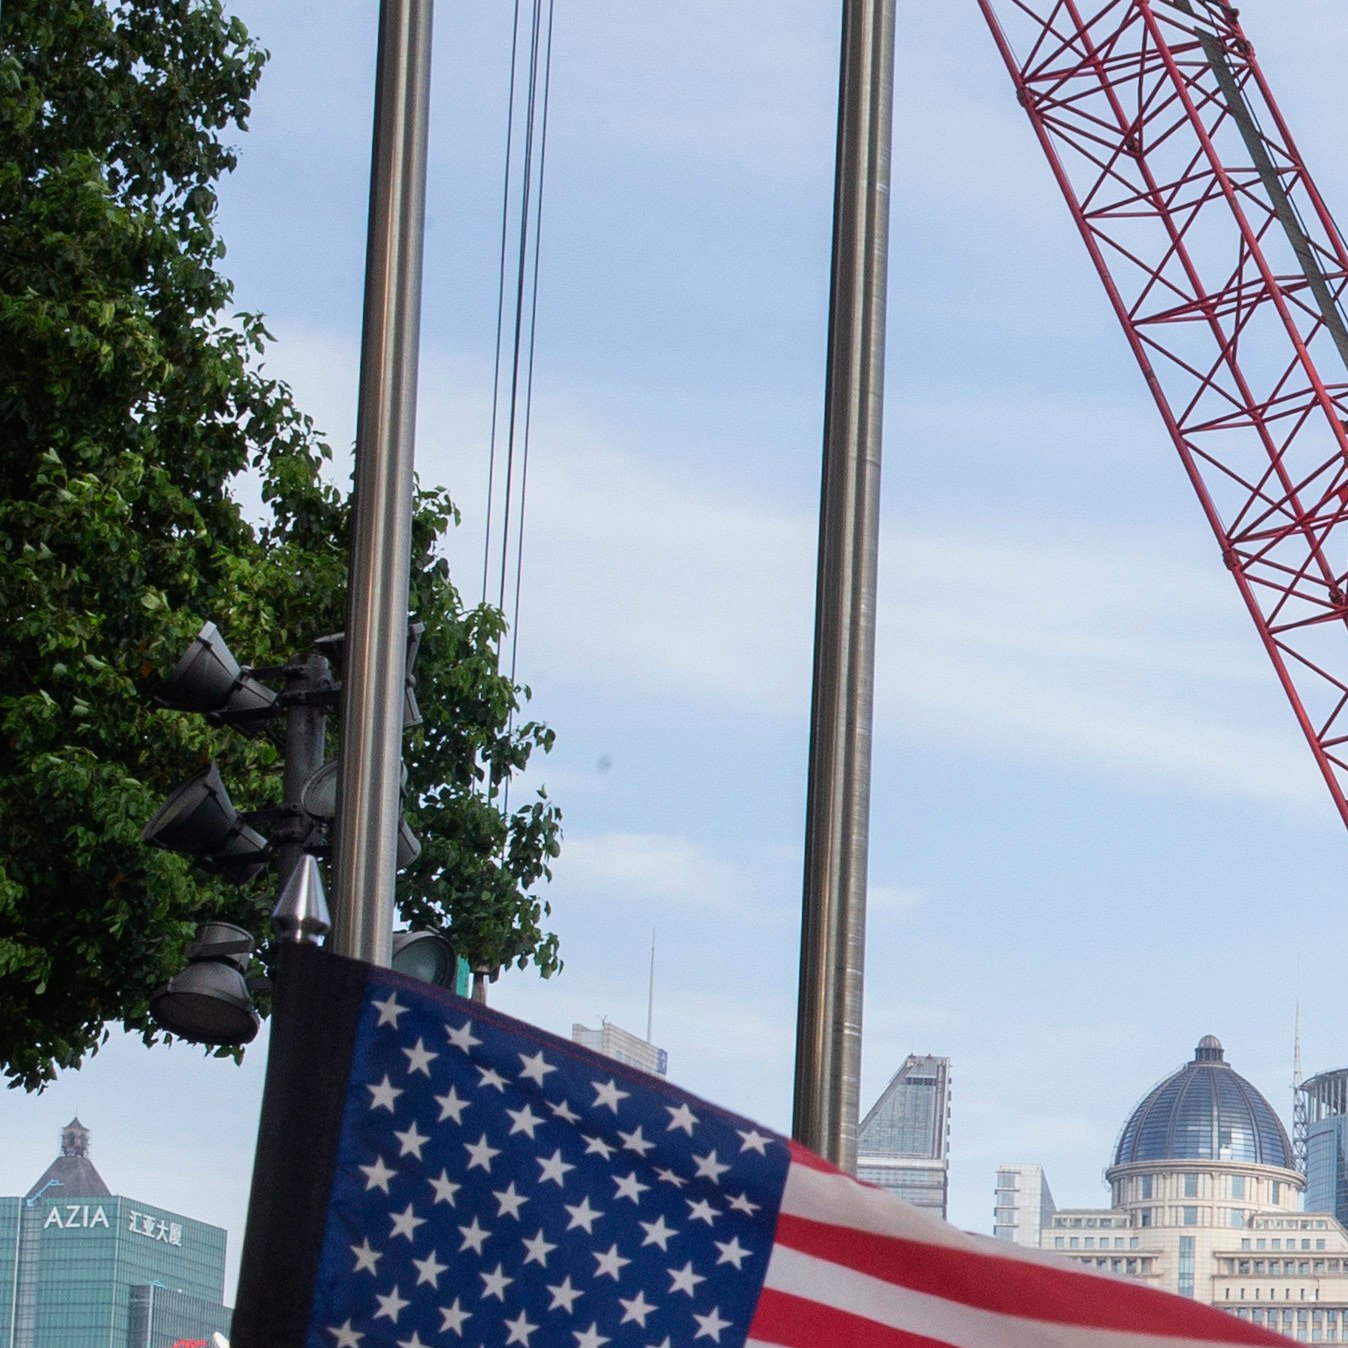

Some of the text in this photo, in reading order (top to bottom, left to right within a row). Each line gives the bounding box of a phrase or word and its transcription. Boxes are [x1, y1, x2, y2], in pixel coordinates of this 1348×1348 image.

[44, 1205, 110, 1229] AZIA
[129, 1209, 183, 1247] 汇亚大厦
